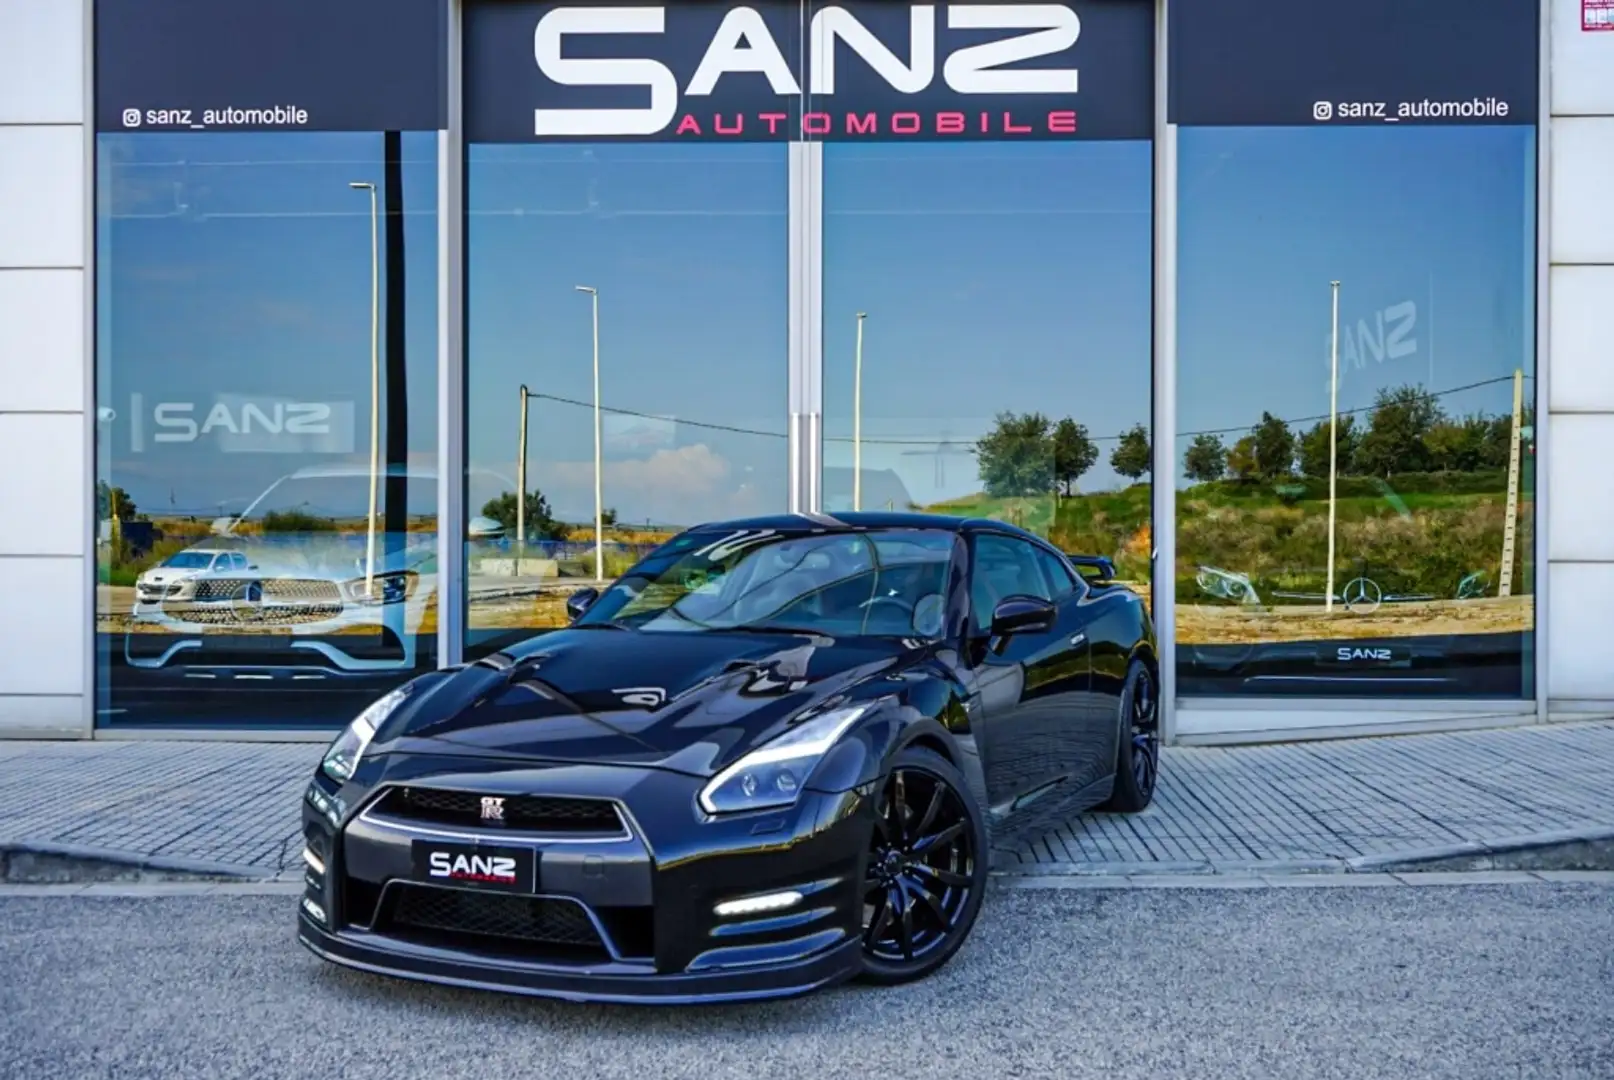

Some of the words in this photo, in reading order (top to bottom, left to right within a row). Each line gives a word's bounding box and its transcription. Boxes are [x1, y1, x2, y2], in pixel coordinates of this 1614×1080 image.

[534, 4, 1081, 135] SANZ
[146, 105, 308, 128] sanz_automobile
[1338, 97, 1509, 121] sanz_automobile
[677, 110, 1077, 135] AUTOMOBILE
[154, 403, 331, 442] SANZ
[1337, 647, 1391, 660] SANZ
[430, 852, 516, 877] SANZ
